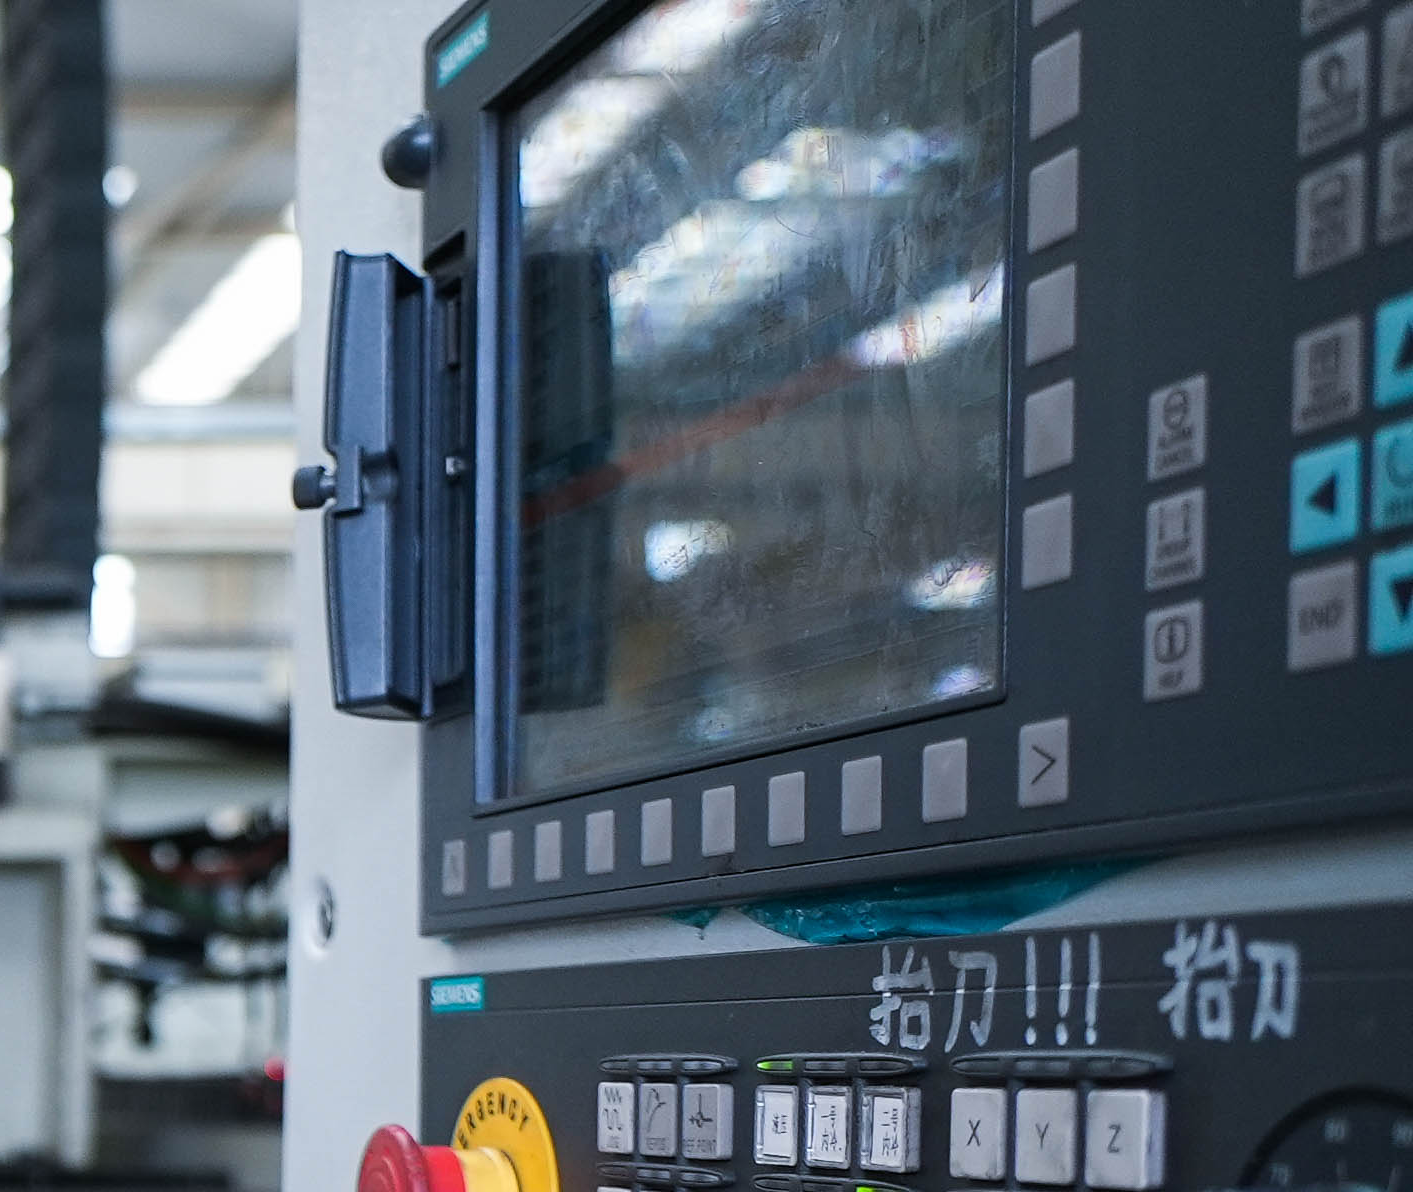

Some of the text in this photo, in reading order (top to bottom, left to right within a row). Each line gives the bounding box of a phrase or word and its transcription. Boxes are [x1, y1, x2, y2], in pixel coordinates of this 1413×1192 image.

[430, 982, 482, 1005] SIEMENS
[455, 1091, 530, 1150] ERGENCY
[966, 1118, 982, 1147] X
[1034, 1122, 1050, 1150] Y
[1107, 1123, 1122, 1154] Z
